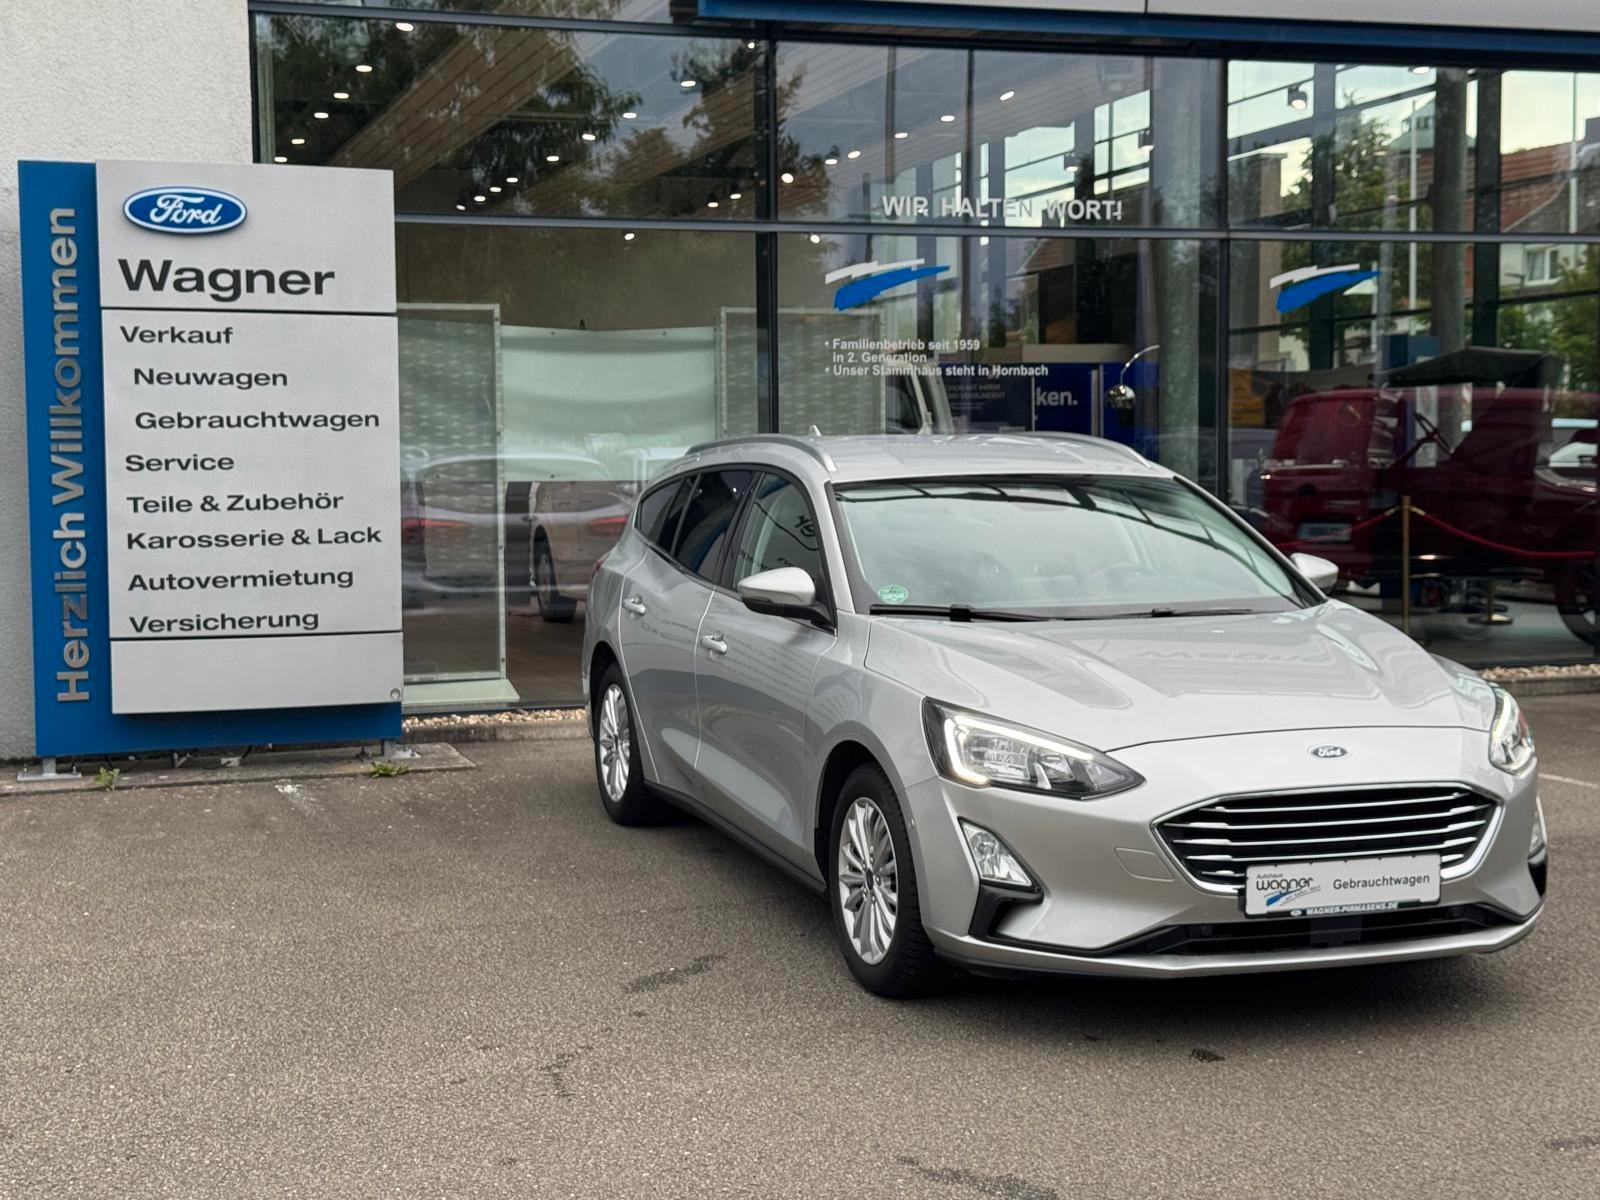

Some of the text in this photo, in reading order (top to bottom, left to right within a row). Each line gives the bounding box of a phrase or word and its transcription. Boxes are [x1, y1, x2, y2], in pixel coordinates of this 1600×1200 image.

[149, 194, 223, 224] Ford
[882, 196, 1123, 220] WIR HALTEN WORT!
[118, 258, 335, 302] Wagner
[120, 325, 234, 345] Verkauf
[832, 339, 980, 350] Familienbetrieb seit 1959
[833, 352, 927, 363] in 2. Generation
[134, 367, 288, 390] Neuwagen
[833, 365, 1049, 376] Unser Stammhaus steht in Hornbach
[135, 410, 379, 432] Gebrauchtwagen
[49, 207, 90, 701] Herzlich Willkommen
[126, 453, 235, 473] Service
[127, 492, 344, 514] Teile & Zubehör
[127, 527, 382, 549] Karosserie & Lack
[128, 569, 354, 592] Autovermietung
[129, 611, 320, 633] Versicherung
[1333, 875, 1430, 890] Gebrauchtwagen
